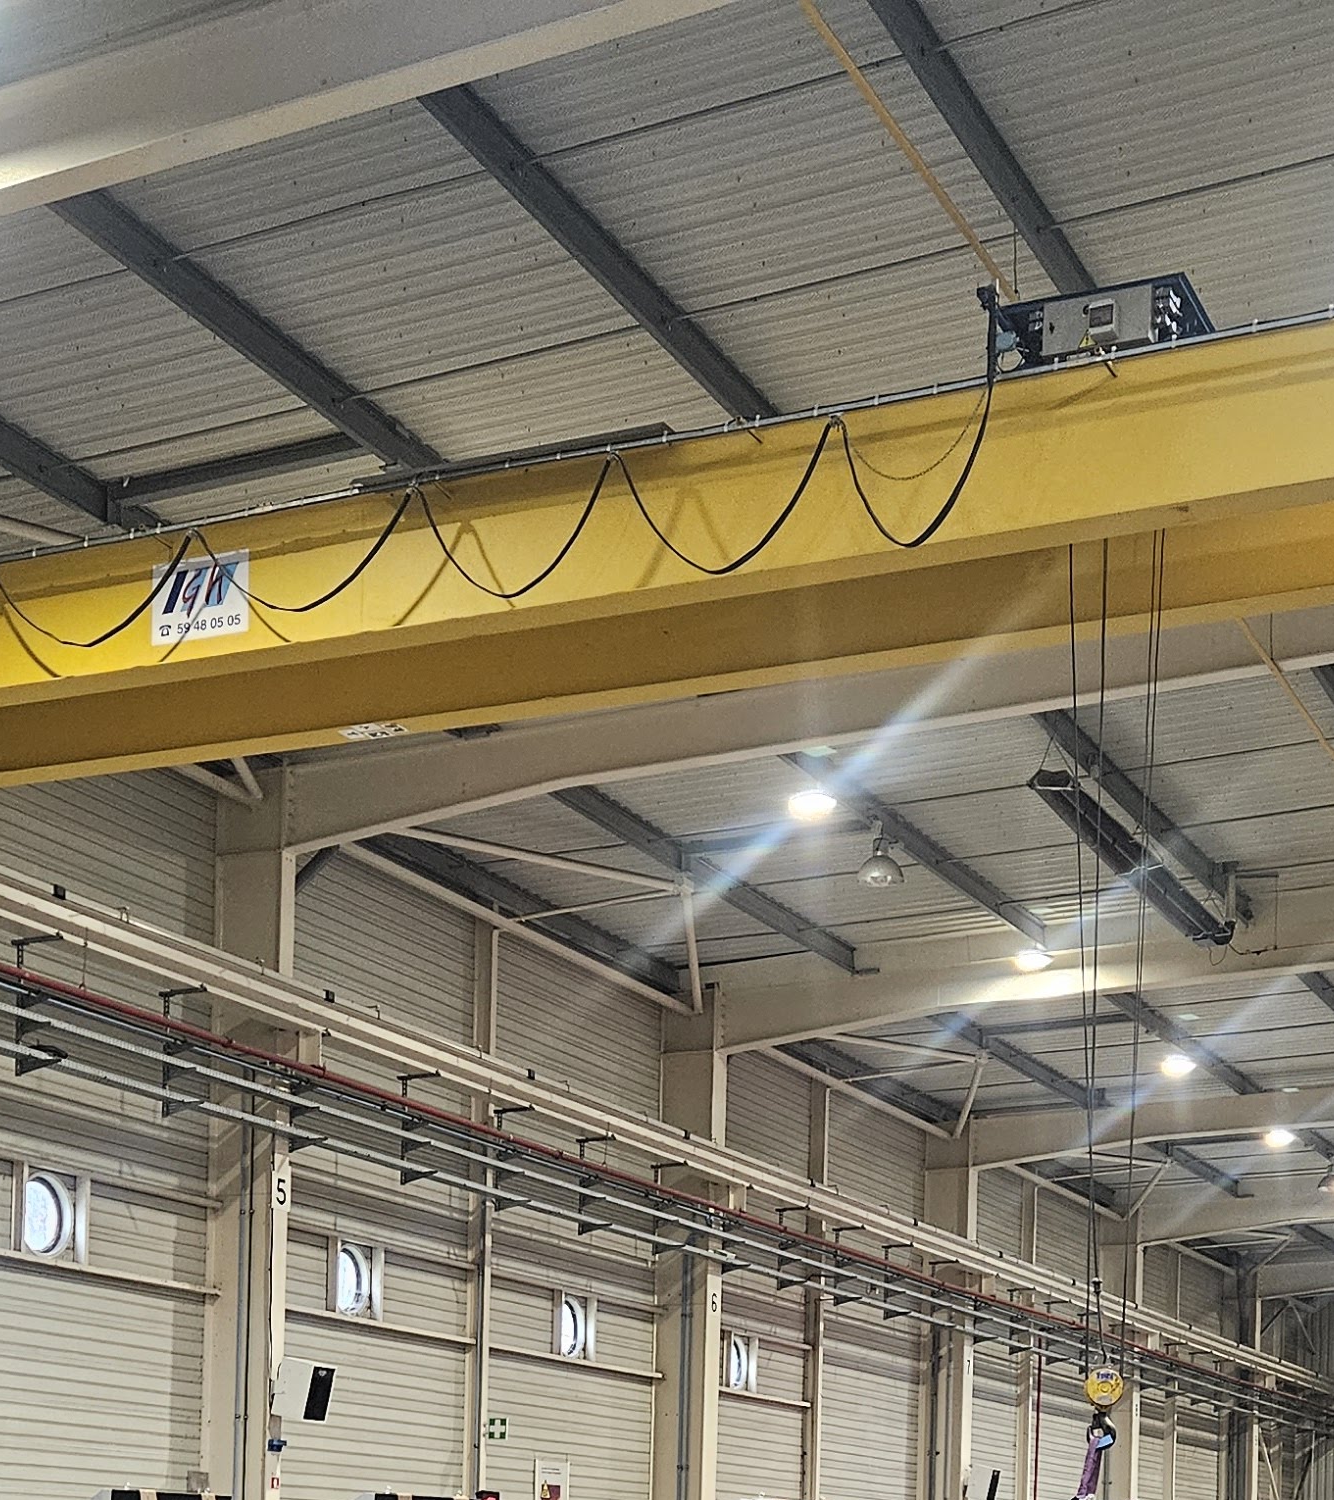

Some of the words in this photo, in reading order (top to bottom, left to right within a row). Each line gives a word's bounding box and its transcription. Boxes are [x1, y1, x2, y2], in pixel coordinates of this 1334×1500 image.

[177, 622, 191, 635] 59
[193, 619, 207, 632] 48
[210, 616, 224, 629] 05
[227, 614, 241, 626] 05
[276, 1178, 286, 1205] 5
[711, 1293, 717, 1312] 6
